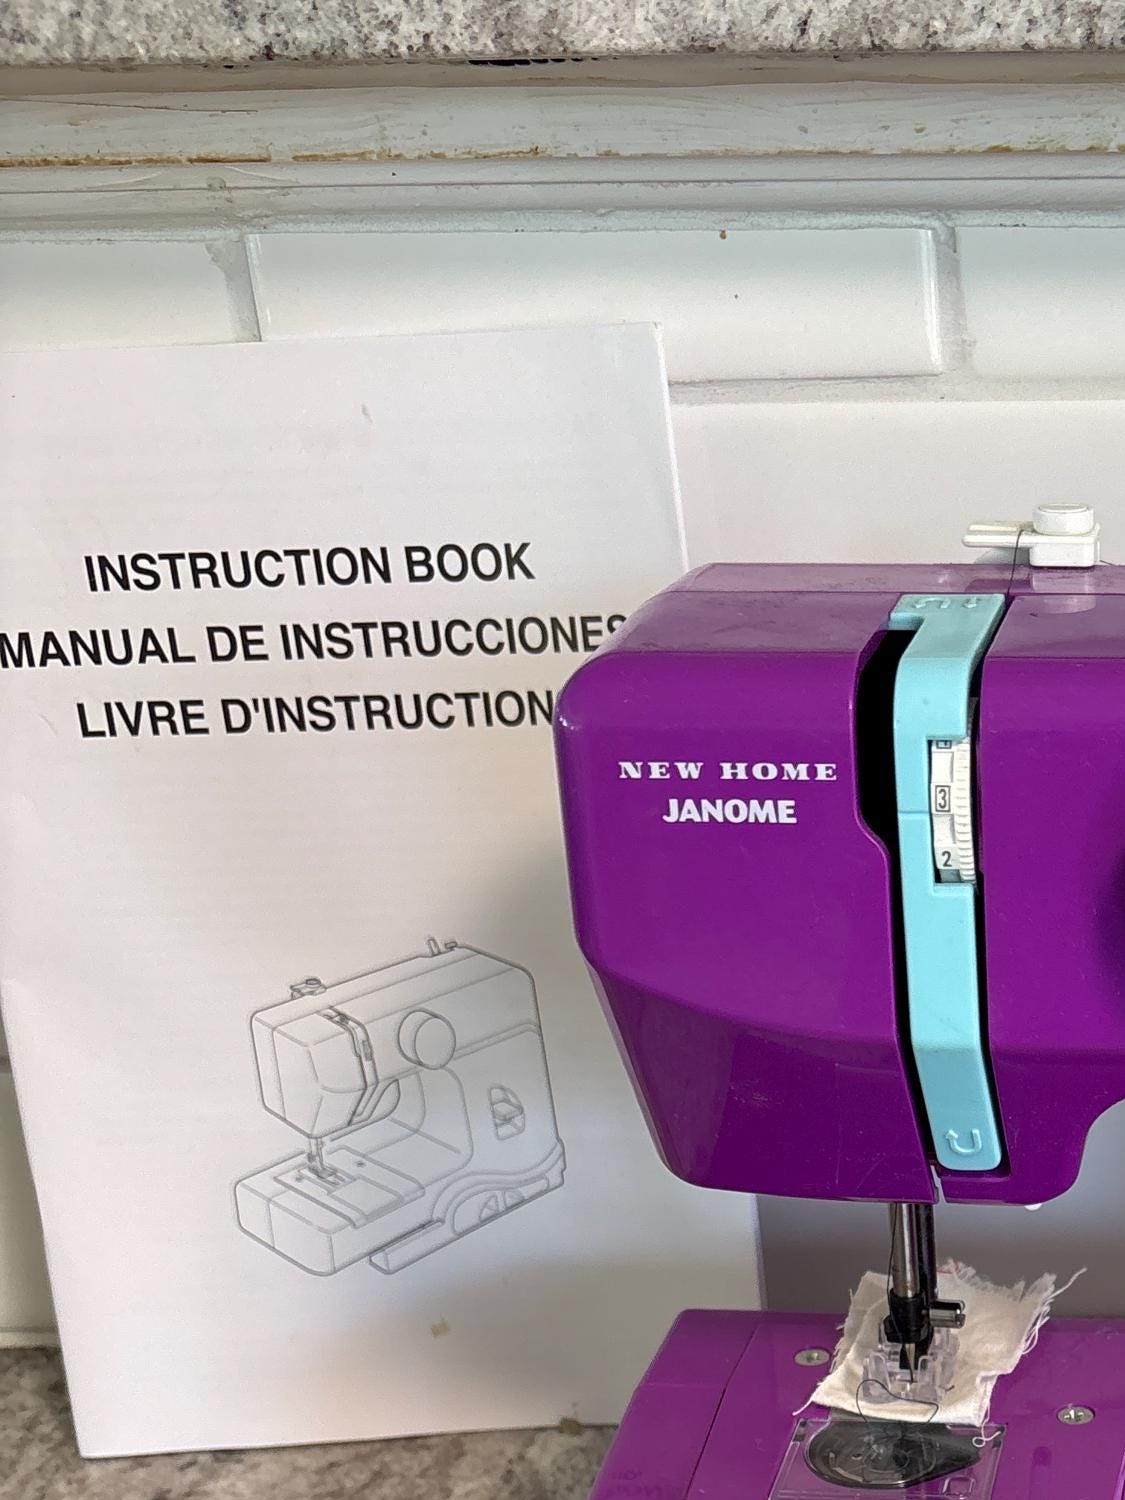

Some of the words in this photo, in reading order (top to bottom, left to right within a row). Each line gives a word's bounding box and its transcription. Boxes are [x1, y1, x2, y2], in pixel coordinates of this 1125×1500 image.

[84, 546, 392, 592] INSTRUCTION
[404, 542, 535, 583] BOOK
[0, 627, 197, 669] MANUAL
[207, 625, 269, 662] DE
[76, 699, 210, 738] LIVRE
[224, 690, 554, 734] D'INSTRUCTION
[618, 761, 705, 779] NEW
[719, 762, 838, 781] HOME
[662, 798, 798, 824] JANOME
[938, 788, 948, 810] 3
[941, 850, 952, 867] 2
